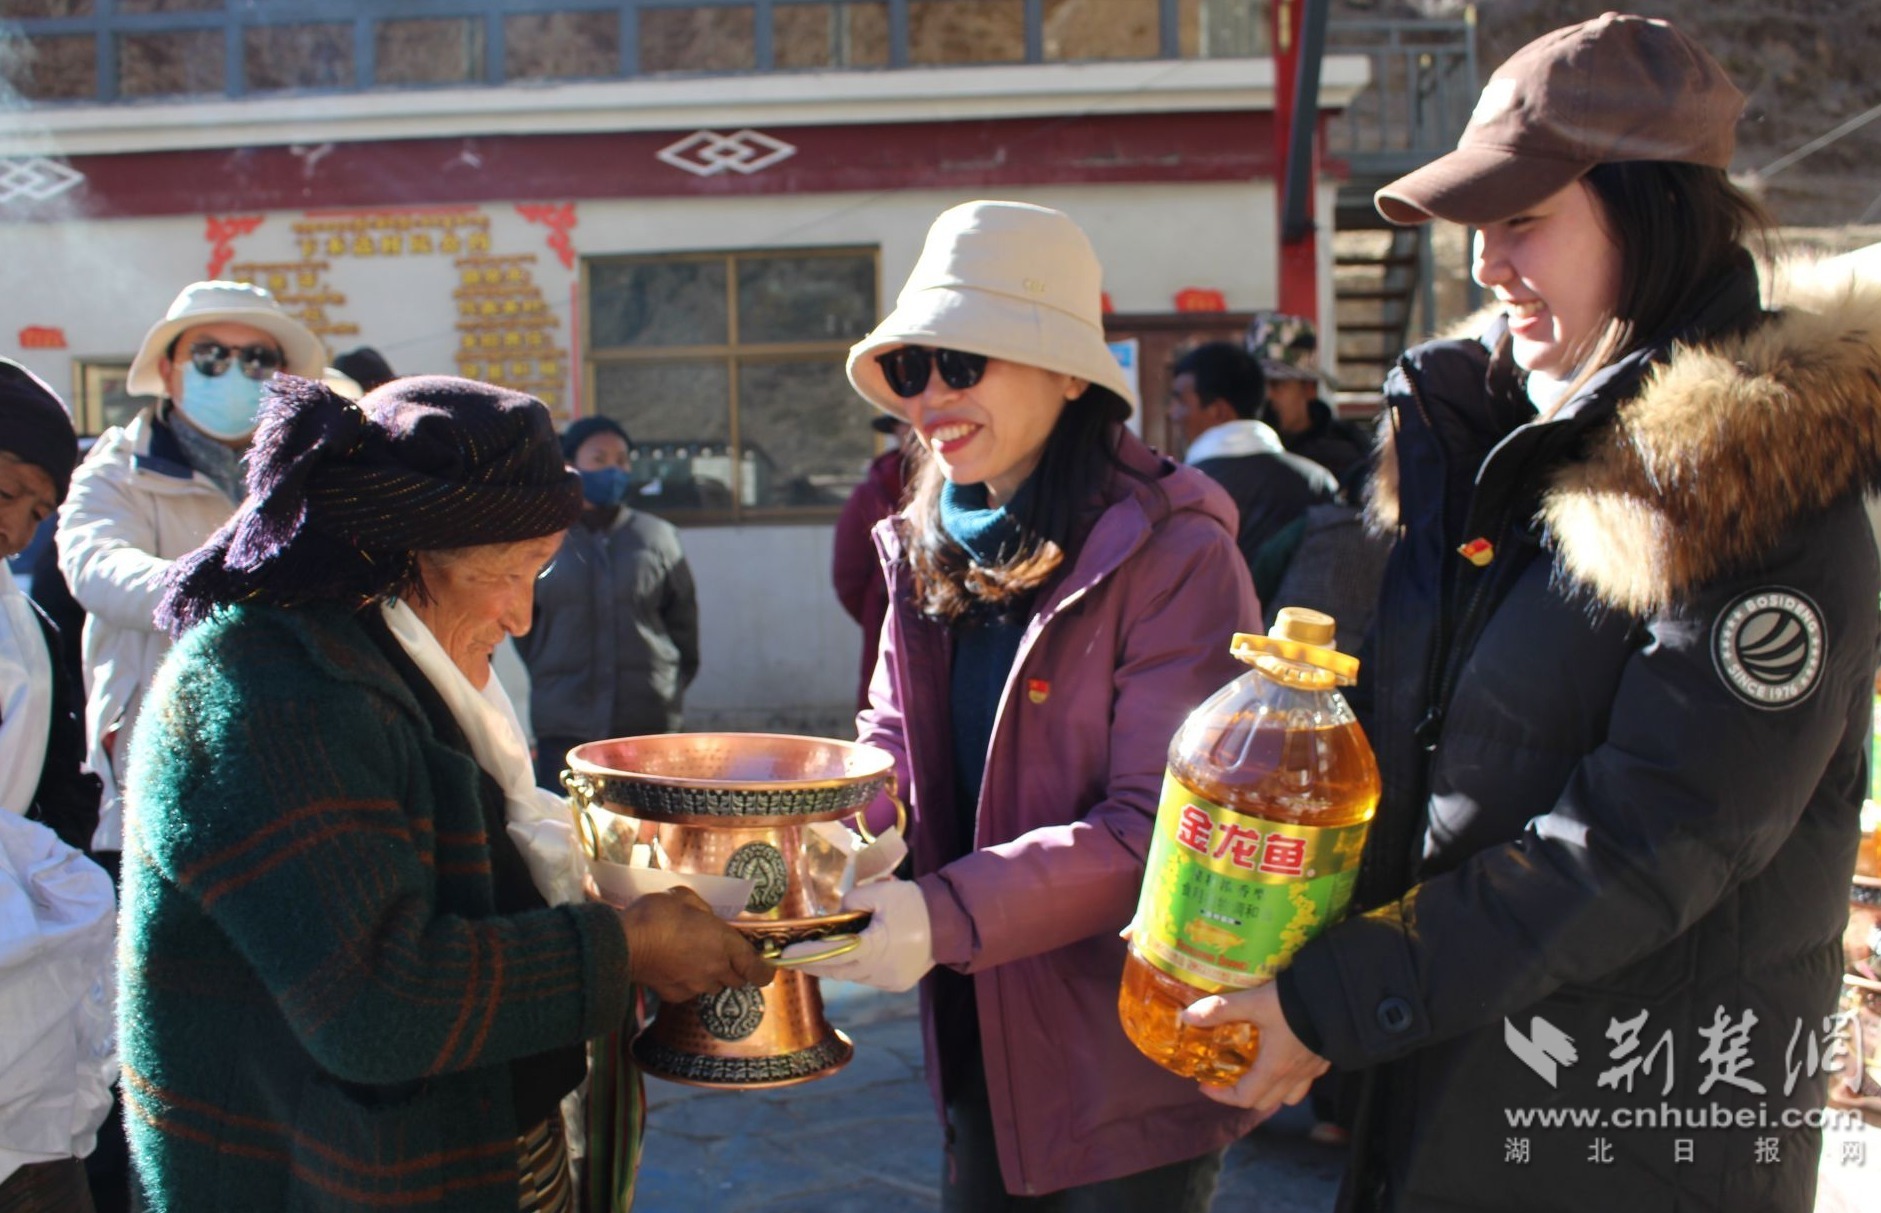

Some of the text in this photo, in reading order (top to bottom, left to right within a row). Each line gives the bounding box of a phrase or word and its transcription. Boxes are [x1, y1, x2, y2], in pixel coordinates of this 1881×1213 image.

[1745, 594, 1818, 632] BOSIDENG
[1728, 664, 1798, 699] SINCE 1976
[1177, 804, 1306, 876] 金龙鱼
